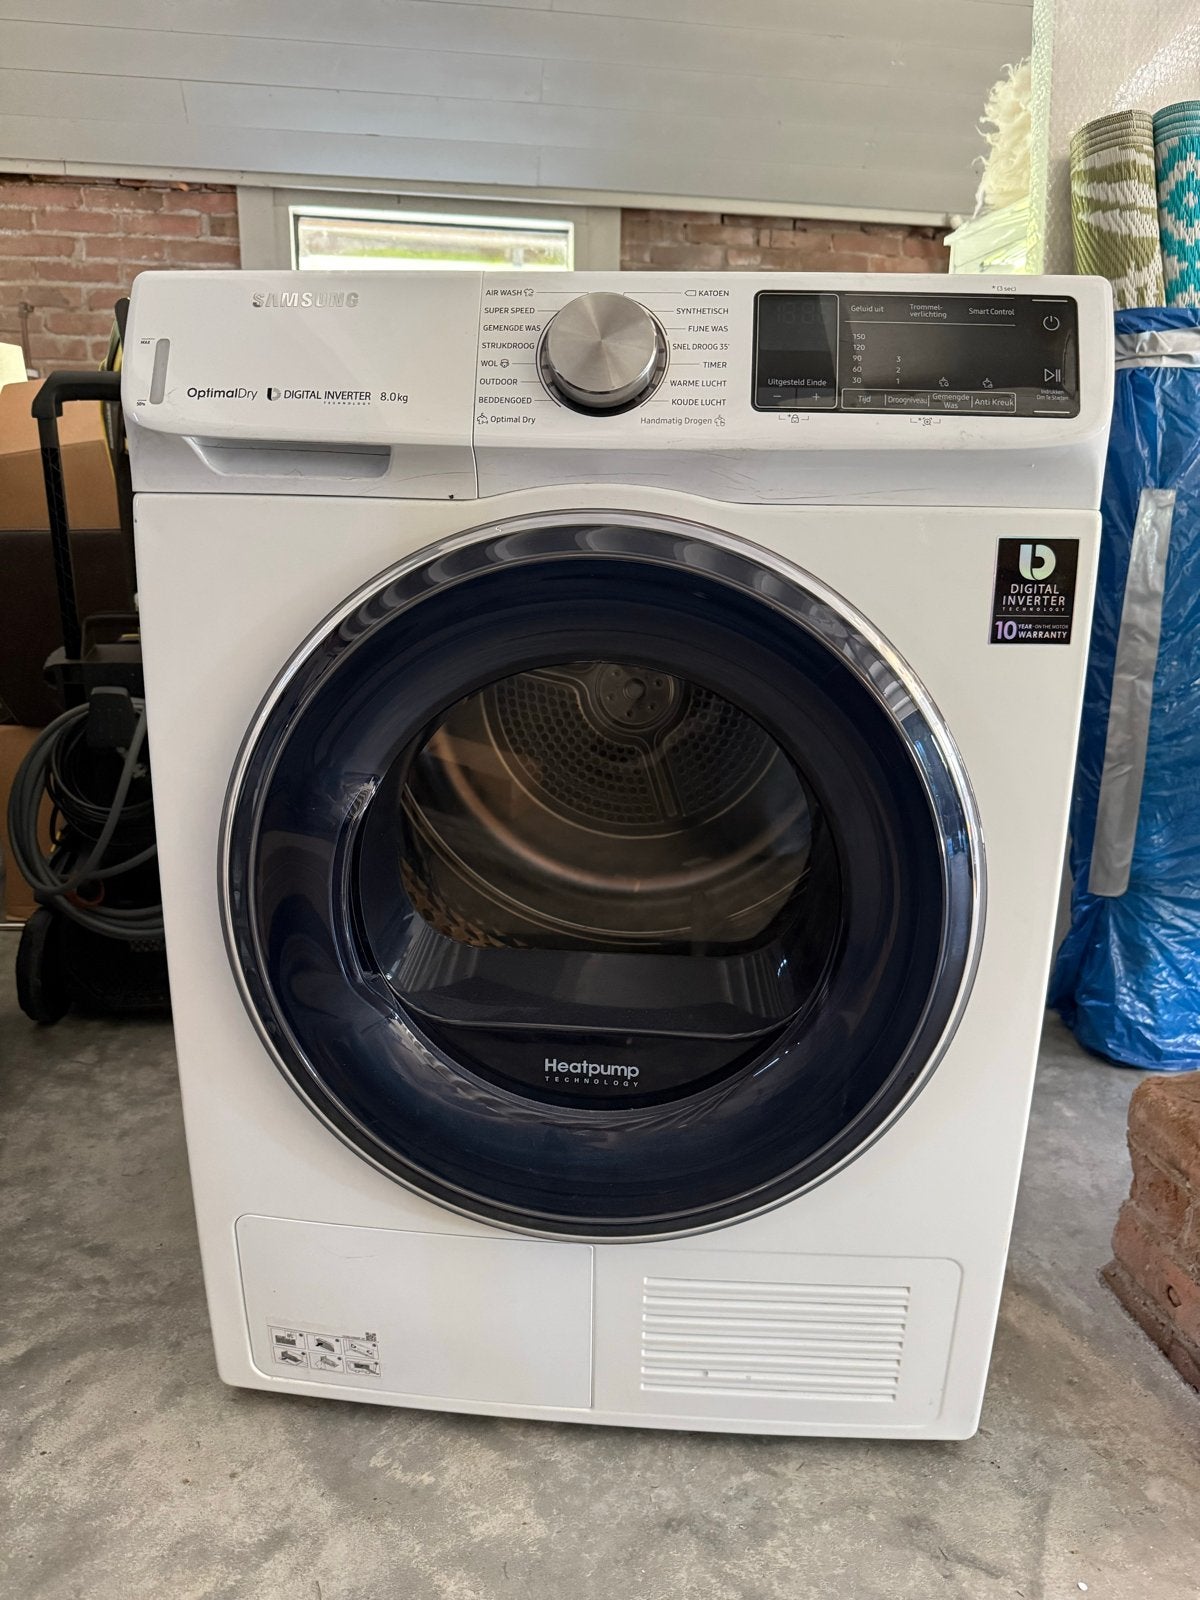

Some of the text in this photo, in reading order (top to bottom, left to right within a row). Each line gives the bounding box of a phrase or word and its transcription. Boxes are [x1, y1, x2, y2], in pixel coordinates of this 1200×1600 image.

[252, 292, 359, 308] SAMSUNG
[676, 307, 729, 315] SYNTHETISCH
[850, 304, 884, 313] Geluid uit
[909, 303, 943, 311] Trommel-
[909, 310, 948, 320] verlichting
[968, 307, 1015, 317] Smart Control
[483, 324, 541, 332] GEMENGDE WAS
[688, 325, 729, 333] FIJNE WAS
[853, 333, 866, 341] 150
[481, 342, 535, 350] STRIJKDROOG
[672, 343, 691, 351] SNEL
[692, 343, 718, 351] DROOG
[480, 360, 498, 368] WOL
[703, 361, 727, 369] TIMER
[852, 366, 863, 374] 60
[480, 378, 518, 386] OUTDOOR
[767, 378, 805, 387] Uitgesteld
[852, 377, 862, 385] 30
[187, 387, 258, 401] OptimalDry
[283, 390, 322, 400] DIGITAL
[324, 391, 371, 401] INVERTER
[932, 393, 970, 403] Gemengde
[478, 397, 532, 405] BEDDENGOED
[671, 398, 727, 406] KOUDE LUCHT
[858, 395, 872, 404] Tijd
[888, 395, 928, 406] Droogniveau
[974, 398, 1014, 408] Anti Kreuk
[943, 402, 959, 410] Was
[490, 415, 536, 425] Optimal Dry
[640, 417, 712, 426] Handmatig Drogen
[1010, 584, 1060, 594] DIGITAL
[1002, 595, 1066, 606] INVERTER
[994, 620, 1018, 640] 10
[1018, 630, 1068, 639] WARRANTY
[544, 1058, 640, 1080] Heatpump
[544, 1076, 639, 1087] TECHNOLOGY
